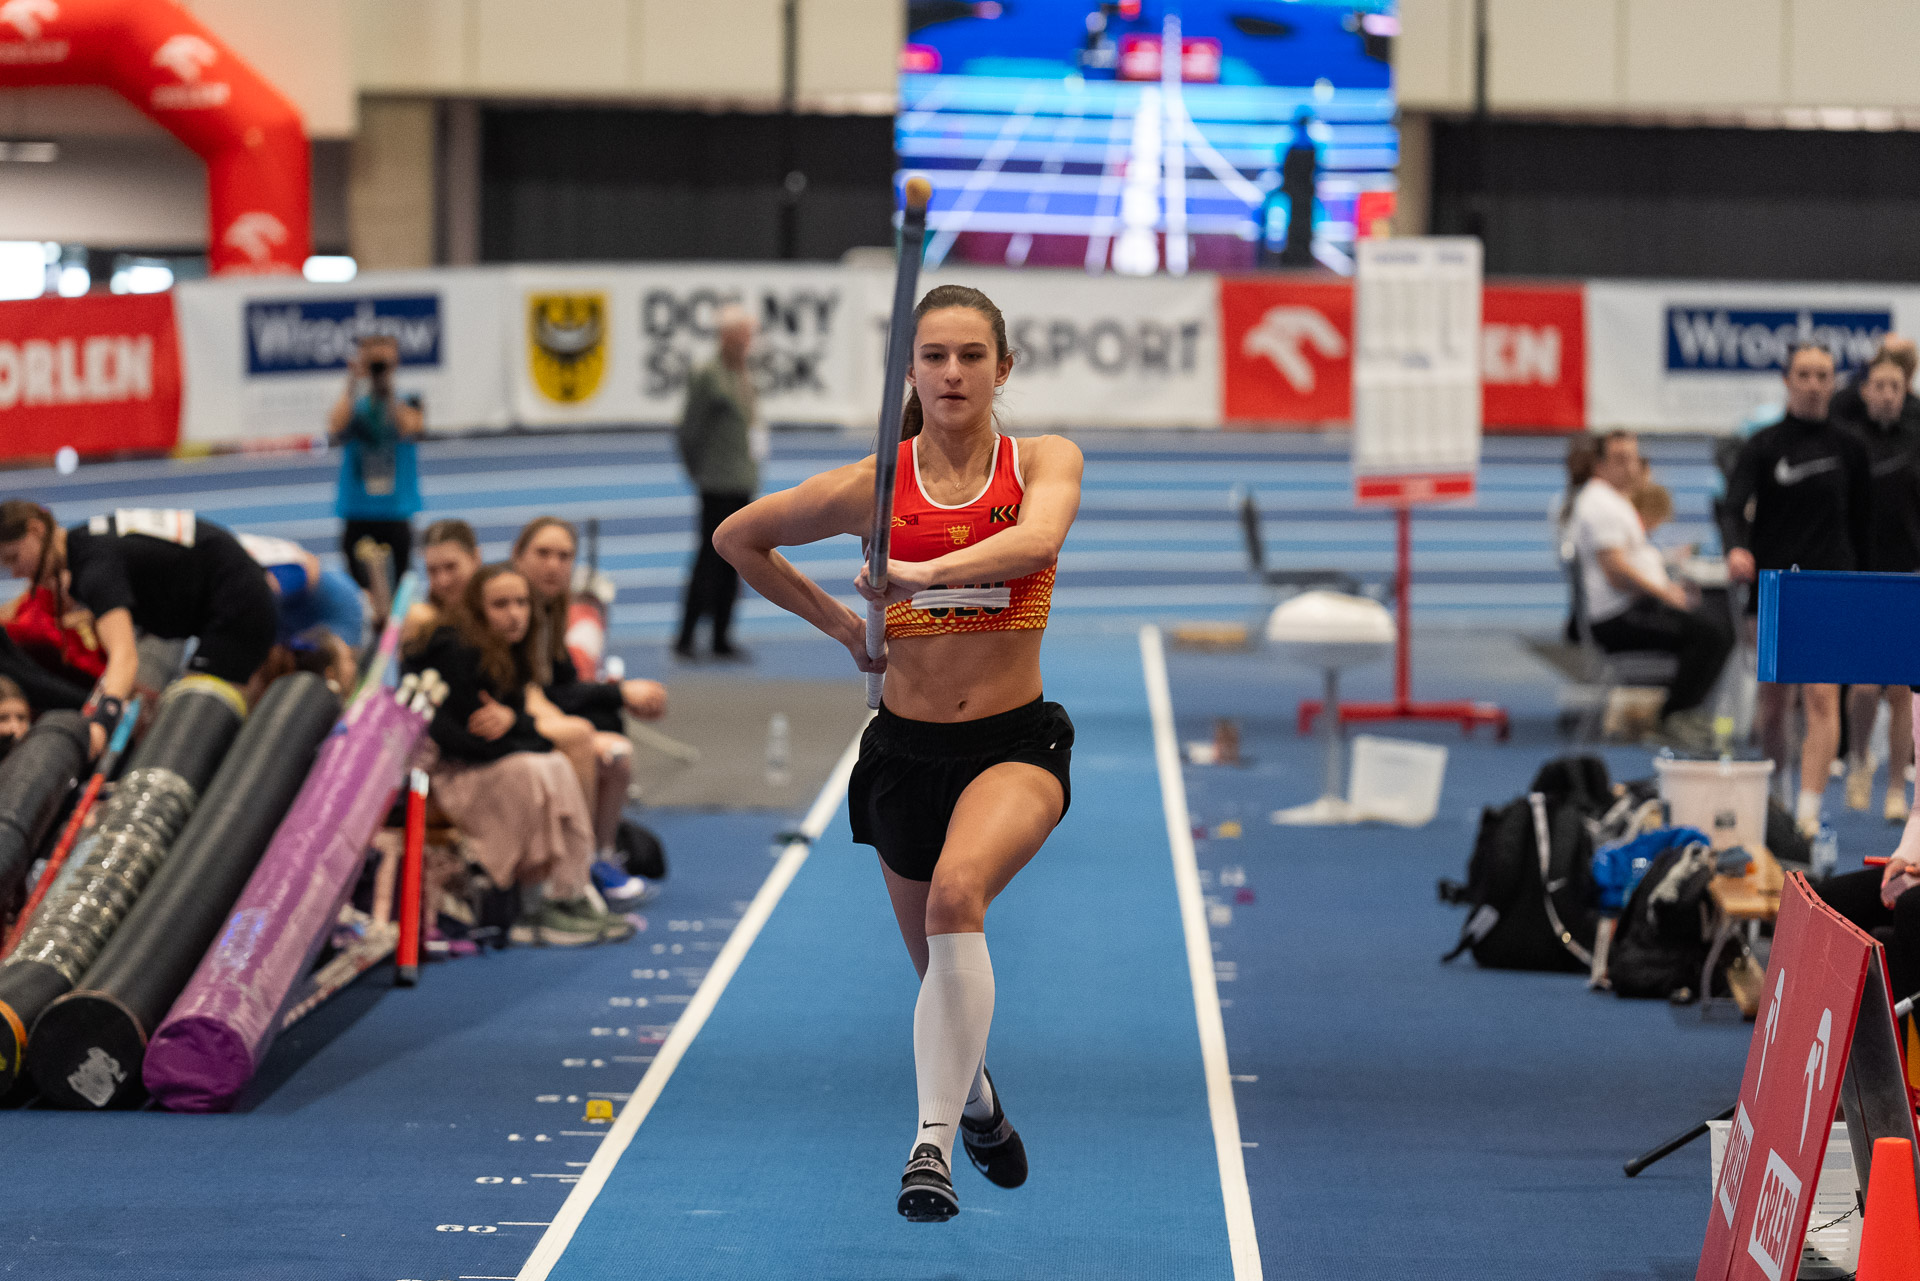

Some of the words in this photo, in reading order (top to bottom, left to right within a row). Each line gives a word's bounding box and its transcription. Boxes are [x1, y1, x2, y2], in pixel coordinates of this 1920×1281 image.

[643, 288, 840, 337] DONY
[0, 335, 154, 410] ORLEN
[1012, 319, 1199, 376] SPORT
[990, 504, 1020, 523] KK
[910, 1159, 940, 1170] NIKE
[1755, 1168, 1797, 1270] ORLEN
